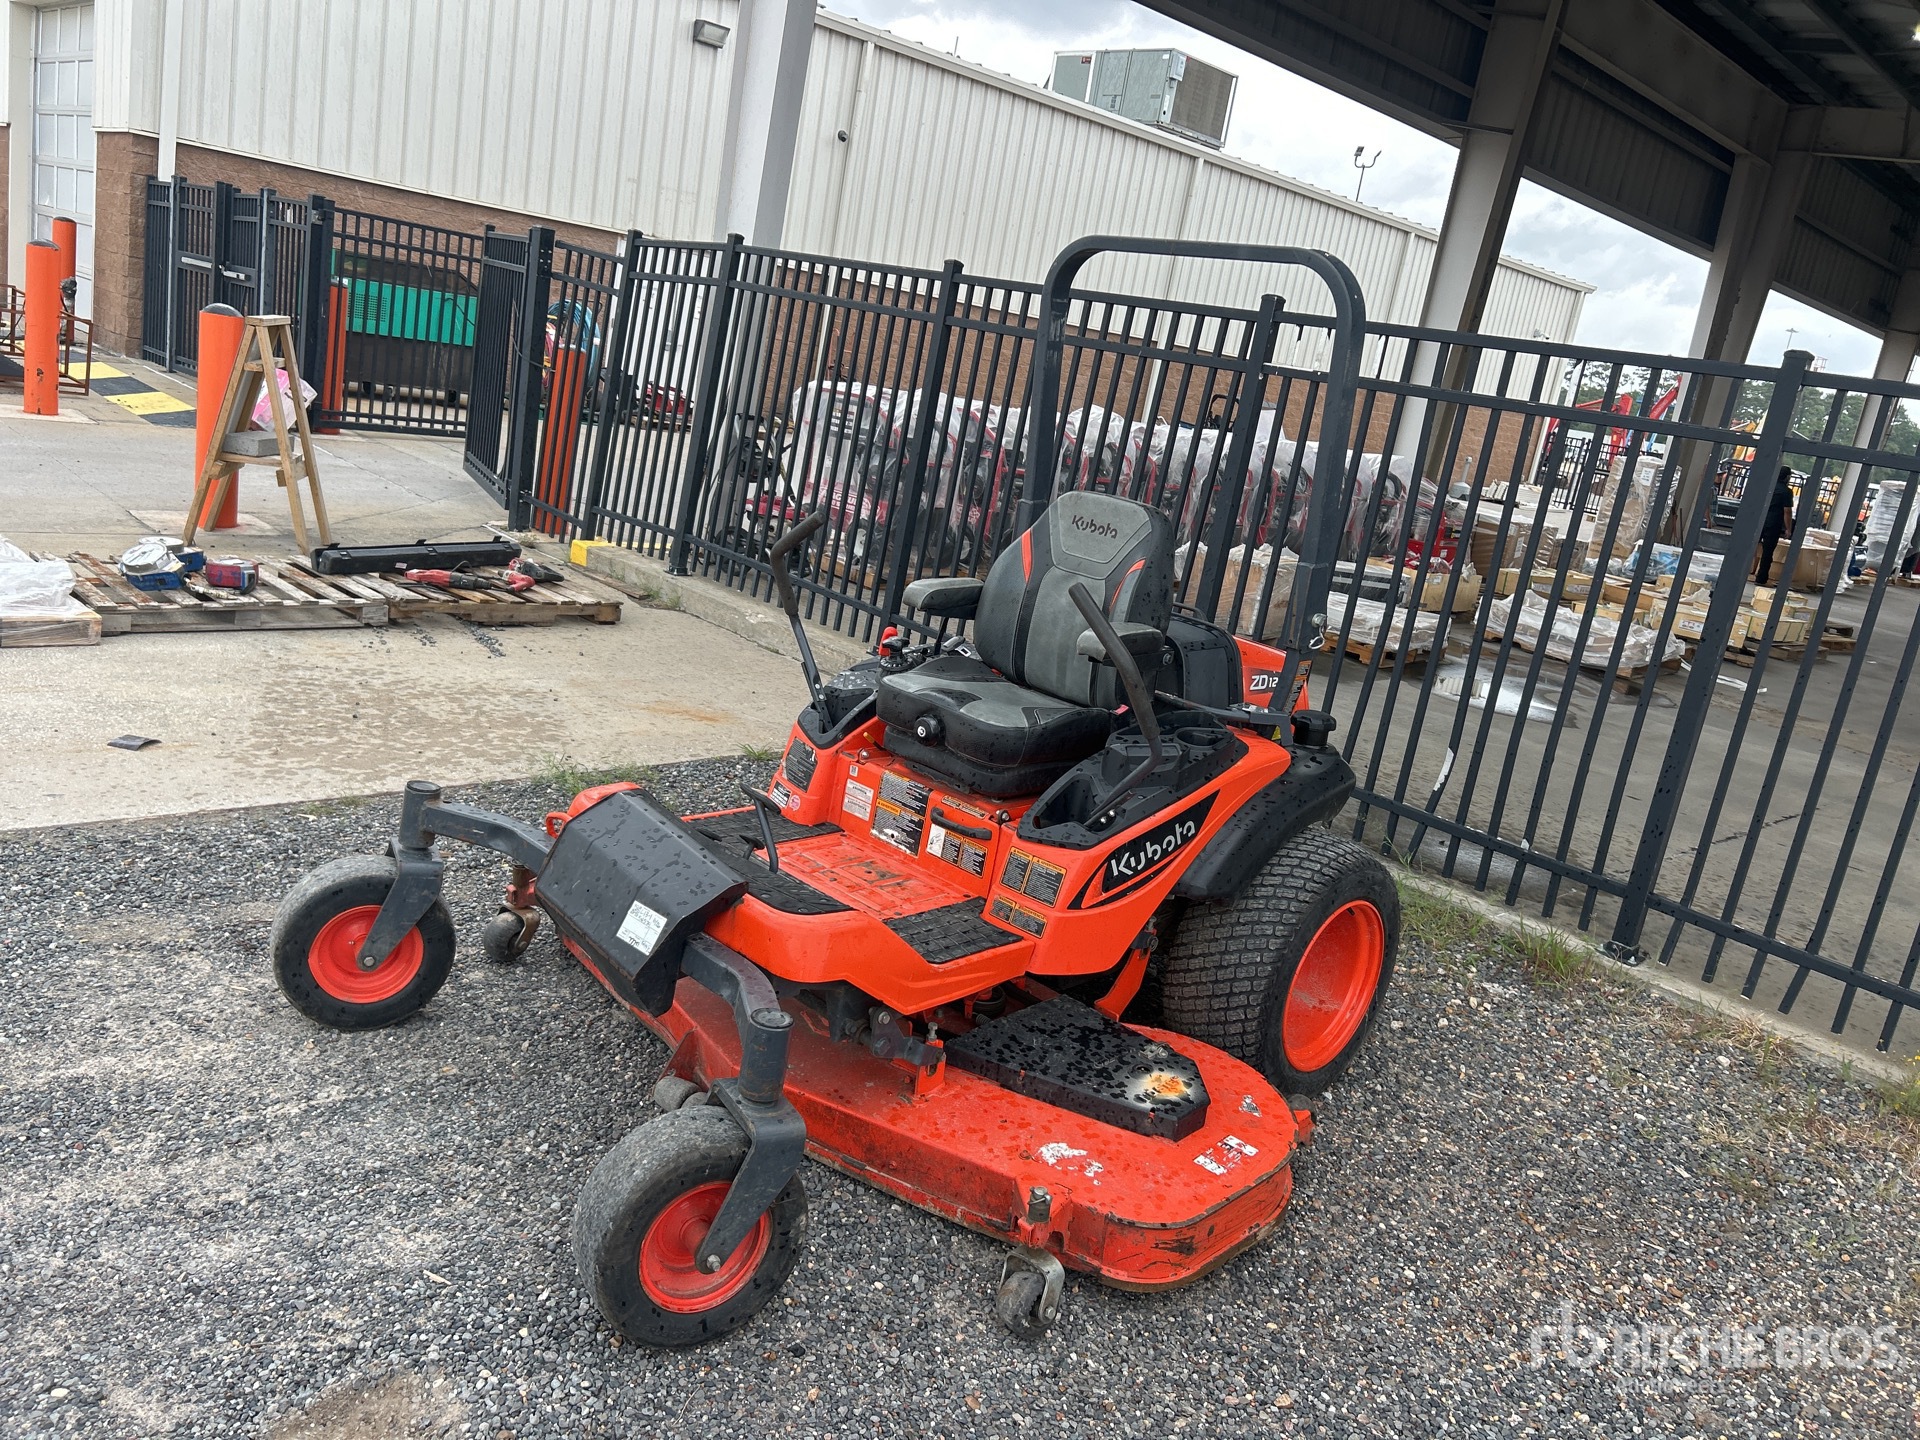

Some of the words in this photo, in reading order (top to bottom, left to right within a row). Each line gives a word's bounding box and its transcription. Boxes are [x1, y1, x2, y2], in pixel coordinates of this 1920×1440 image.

[1072, 515, 1118, 539] Kubota
[1249, 675, 1279, 691] ZD12
[1110, 820, 1196, 877] Kubota
